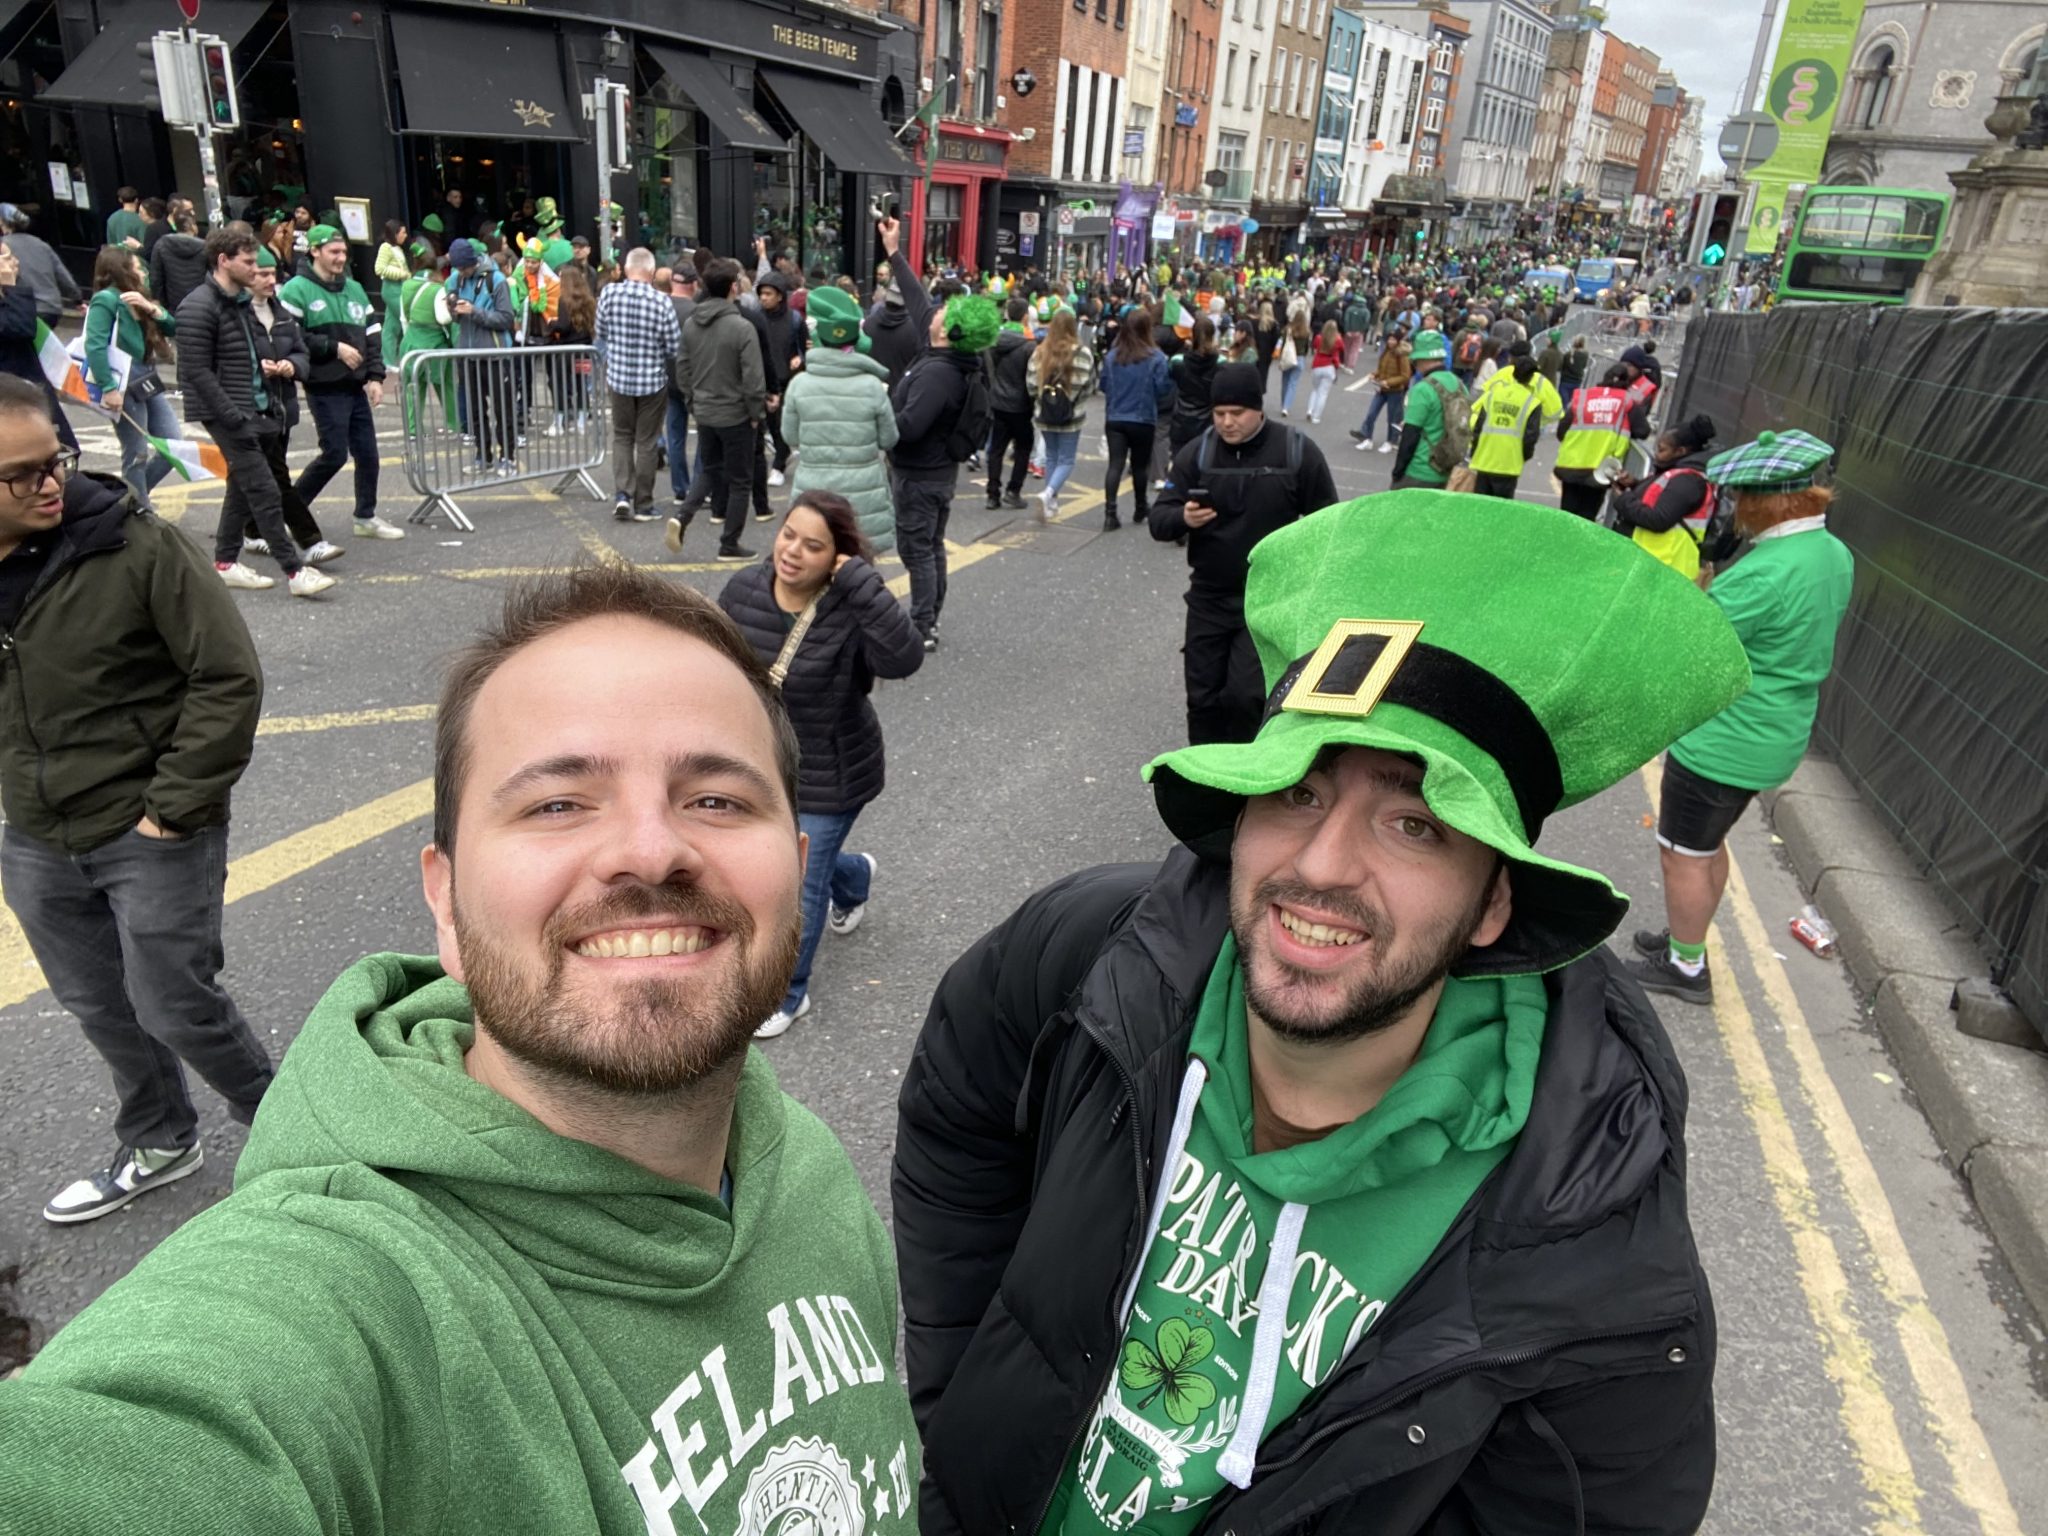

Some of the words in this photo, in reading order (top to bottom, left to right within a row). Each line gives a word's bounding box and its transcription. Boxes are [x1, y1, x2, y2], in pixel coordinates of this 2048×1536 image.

[772, 24, 793, 44] THE
[795, 30, 820, 51] BEER
[821, 37, 858, 61] TEMPLE
[1368, 70, 1387, 134] OLYMPIA
[1404, 72, 1420, 133] THEATRE
[1587, 397, 1621, 413] SECURITY
[1157, 1248, 1259, 1338] DAY
[1160, 1150, 1387, 1389] PATRCK'S
[1214, 1355, 1238, 1381] EDITION
